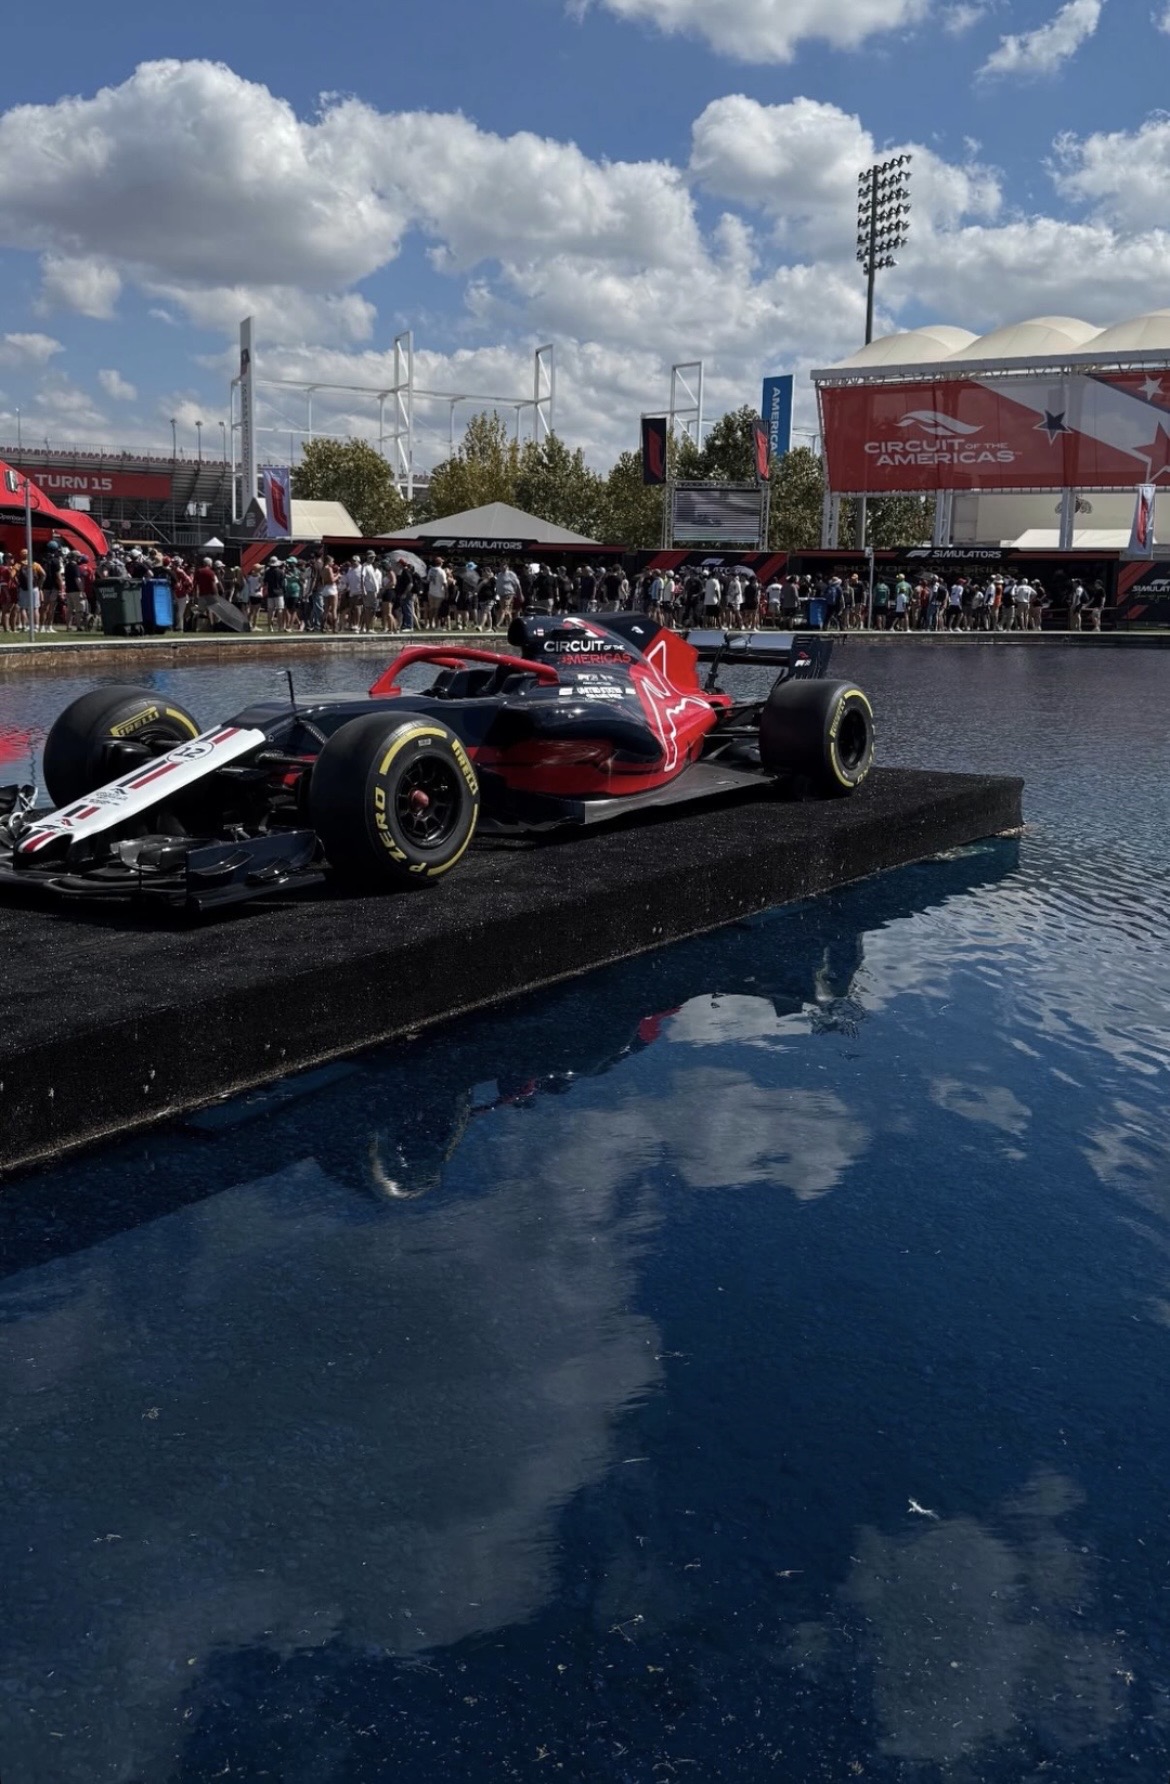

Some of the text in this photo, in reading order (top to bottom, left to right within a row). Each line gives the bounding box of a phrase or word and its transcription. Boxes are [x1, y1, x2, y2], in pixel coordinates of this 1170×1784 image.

[770, 386, 781, 455] AMERICA
[864, 439, 965, 454] CIRCUIT
[876, 450, 1015, 466] AMERICAS
[35, 474, 113, 490] TURN 15
[457, 541, 522, 549] SIMULATORS
[931, 550, 1002, 558] SIMULATORS
[543, 640, 604, 652] CIRCUIT
